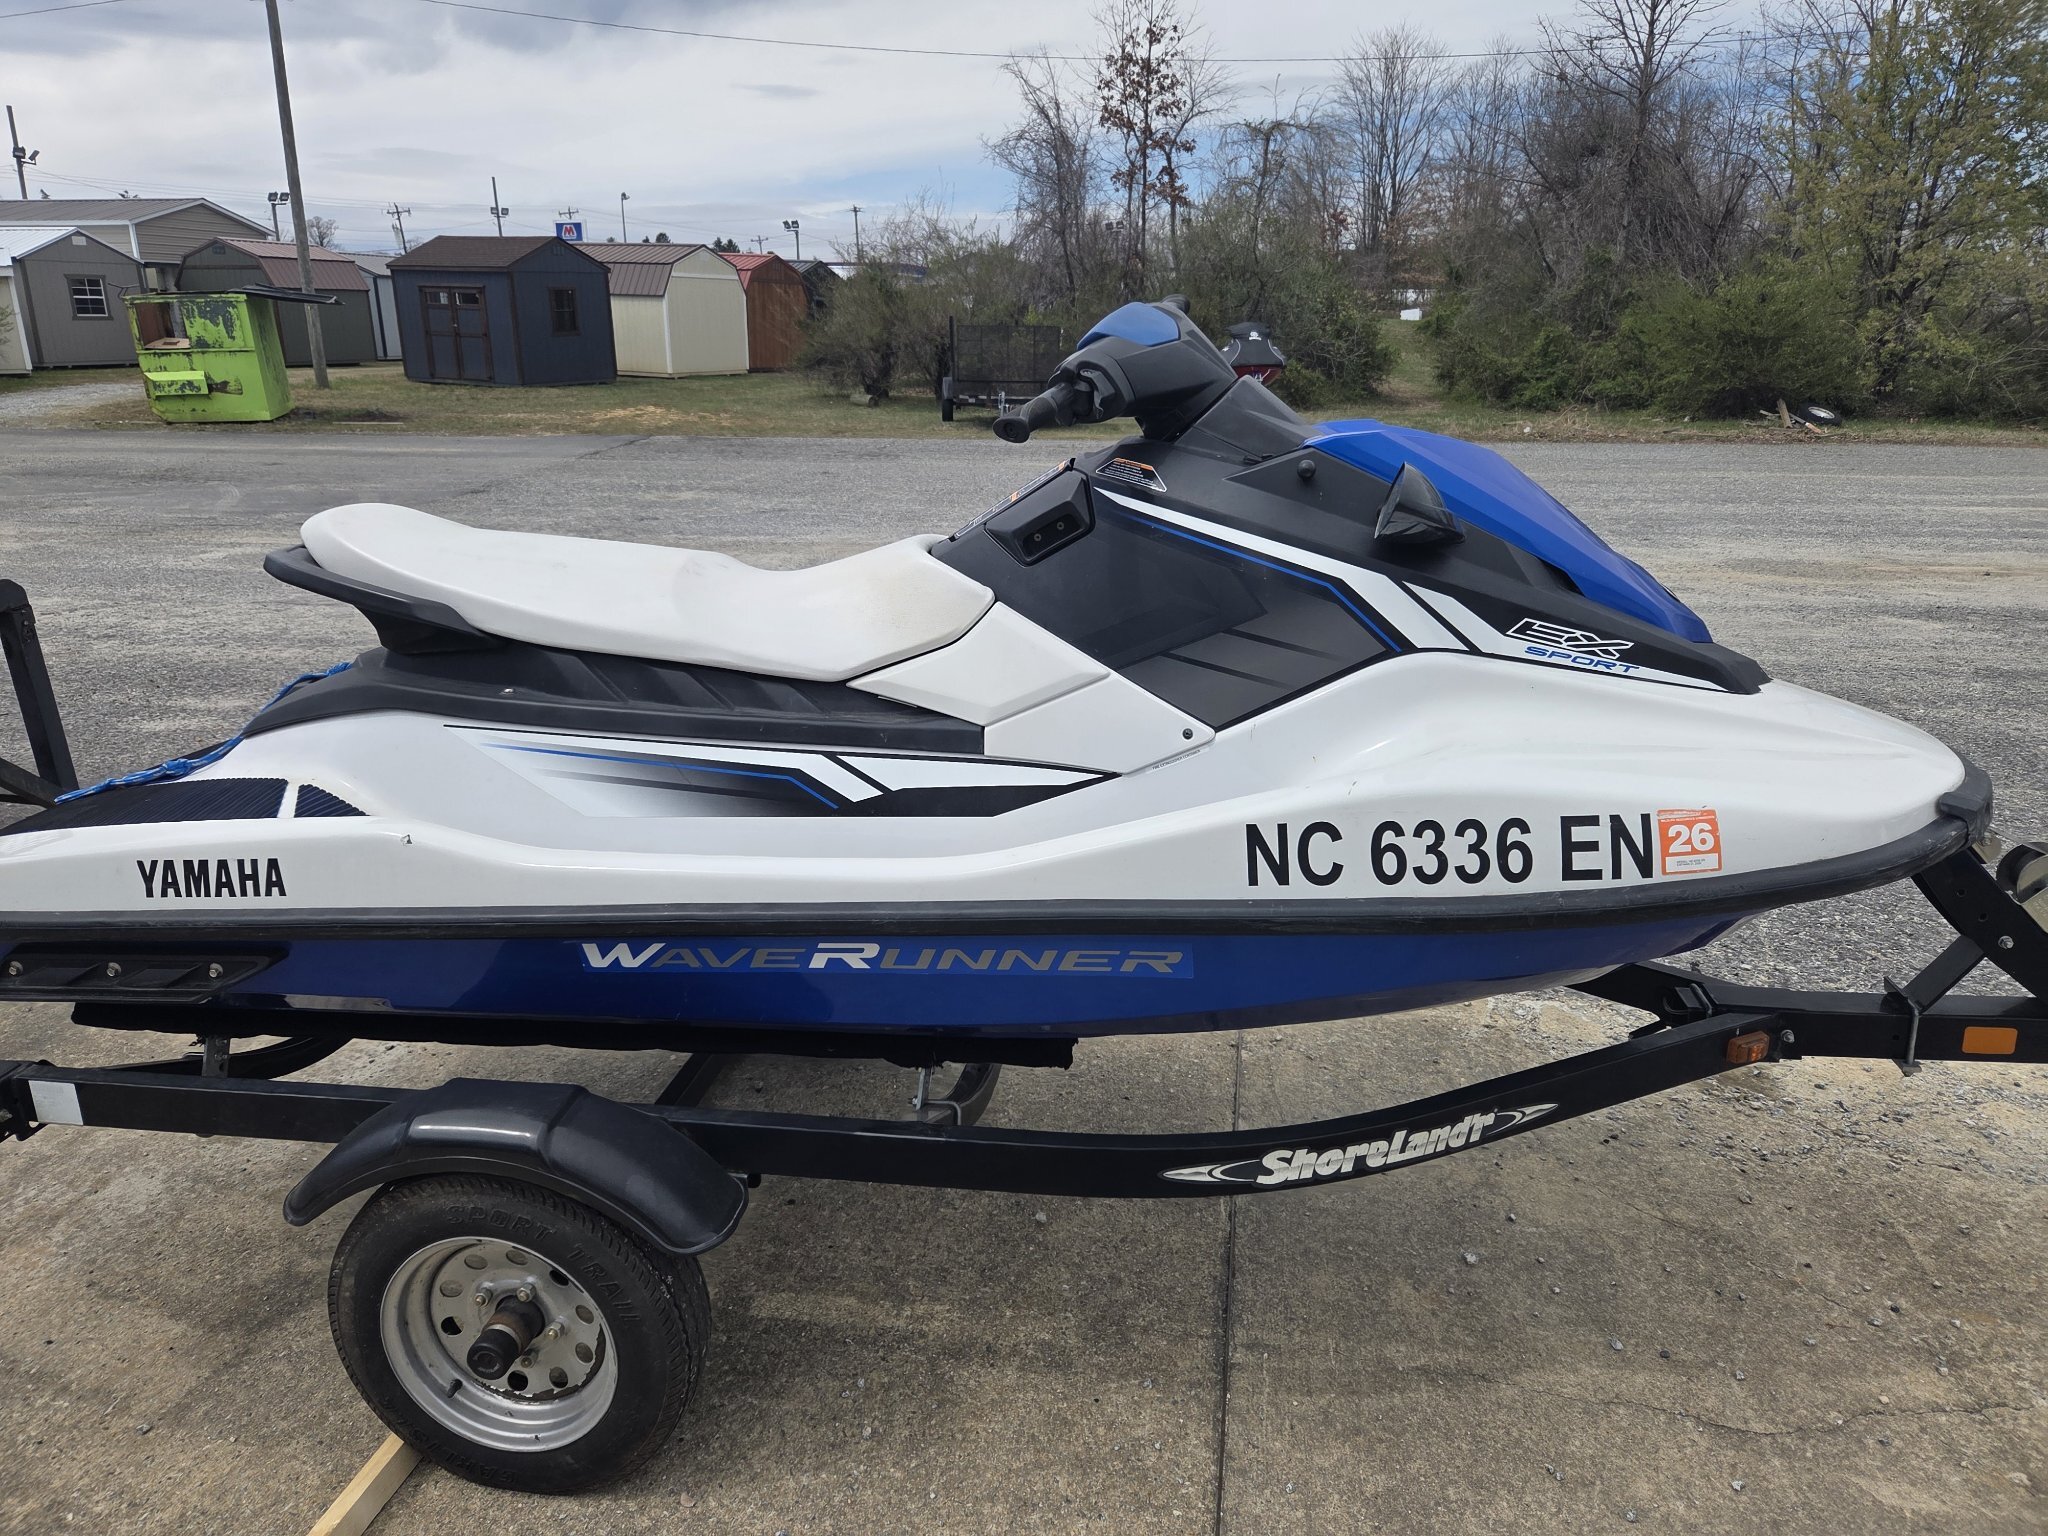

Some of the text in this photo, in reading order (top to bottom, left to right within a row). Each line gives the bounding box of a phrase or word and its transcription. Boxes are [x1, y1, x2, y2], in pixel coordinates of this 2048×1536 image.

[1505, 617, 1635, 660] EX
[1524, 645, 1640, 673] SPORT
[1245, 813, 1654, 887] NC 6336 EN
[1668, 822, 1715, 853] 26
[136, 857, 288, 898] YAMAHA
[447, 1203, 641, 1321] SPORT TRAIL
